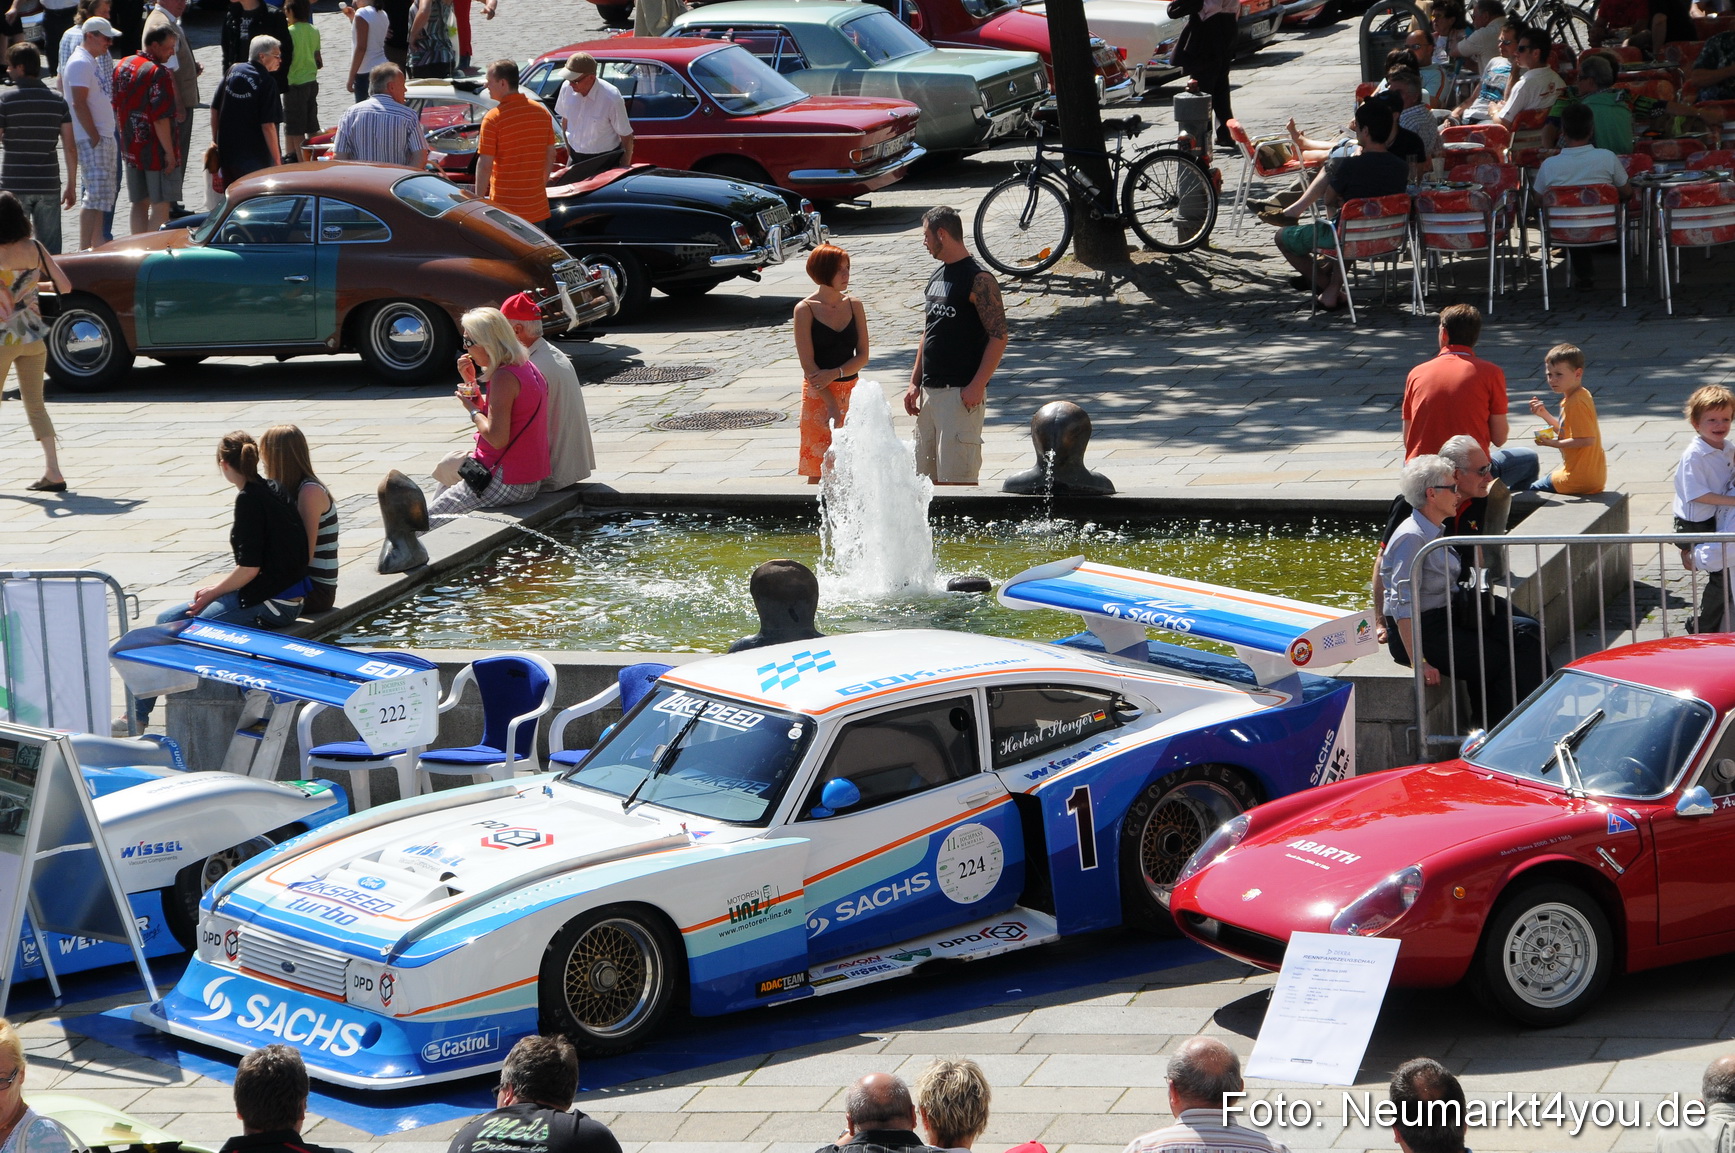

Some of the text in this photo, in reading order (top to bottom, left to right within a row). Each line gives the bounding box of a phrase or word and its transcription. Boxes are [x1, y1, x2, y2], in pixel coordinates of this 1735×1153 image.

[1125, 607, 1196, 632] SACHS
[211, 670, 272, 690] SACHS
[836, 658, 1030, 696] GDK Gasregler
[379, 704, 407, 724] 222
[652, 689, 765, 731] ZAKSPEED
[999, 714, 1093, 756] Herbert Stenger
[1310, 729, 1335, 785] SACHS
[1066, 783, 1099, 871] 1
[1286, 839, 1362, 865] ABARTH
[958, 855, 986, 880] 224
[287, 875, 396, 914] ZAKSPEED
[727, 889, 760, 906] MOTOREN
[835, 871, 931, 922] SACHS
[285, 896, 359, 926] turbo
[718, 907, 792, 938] www.motoren-linz.de
[203, 930, 222, 947] DPD
[937, 934, 983, 949] DPD
[837, 955, 881, 969] AVON
[353, 975, 374, 992] DPD
[236, 993, 367, 1057] SACHS
[441, 1032, 490, 1057] Castrol
[477, 1117, 550, 1141] Mels
